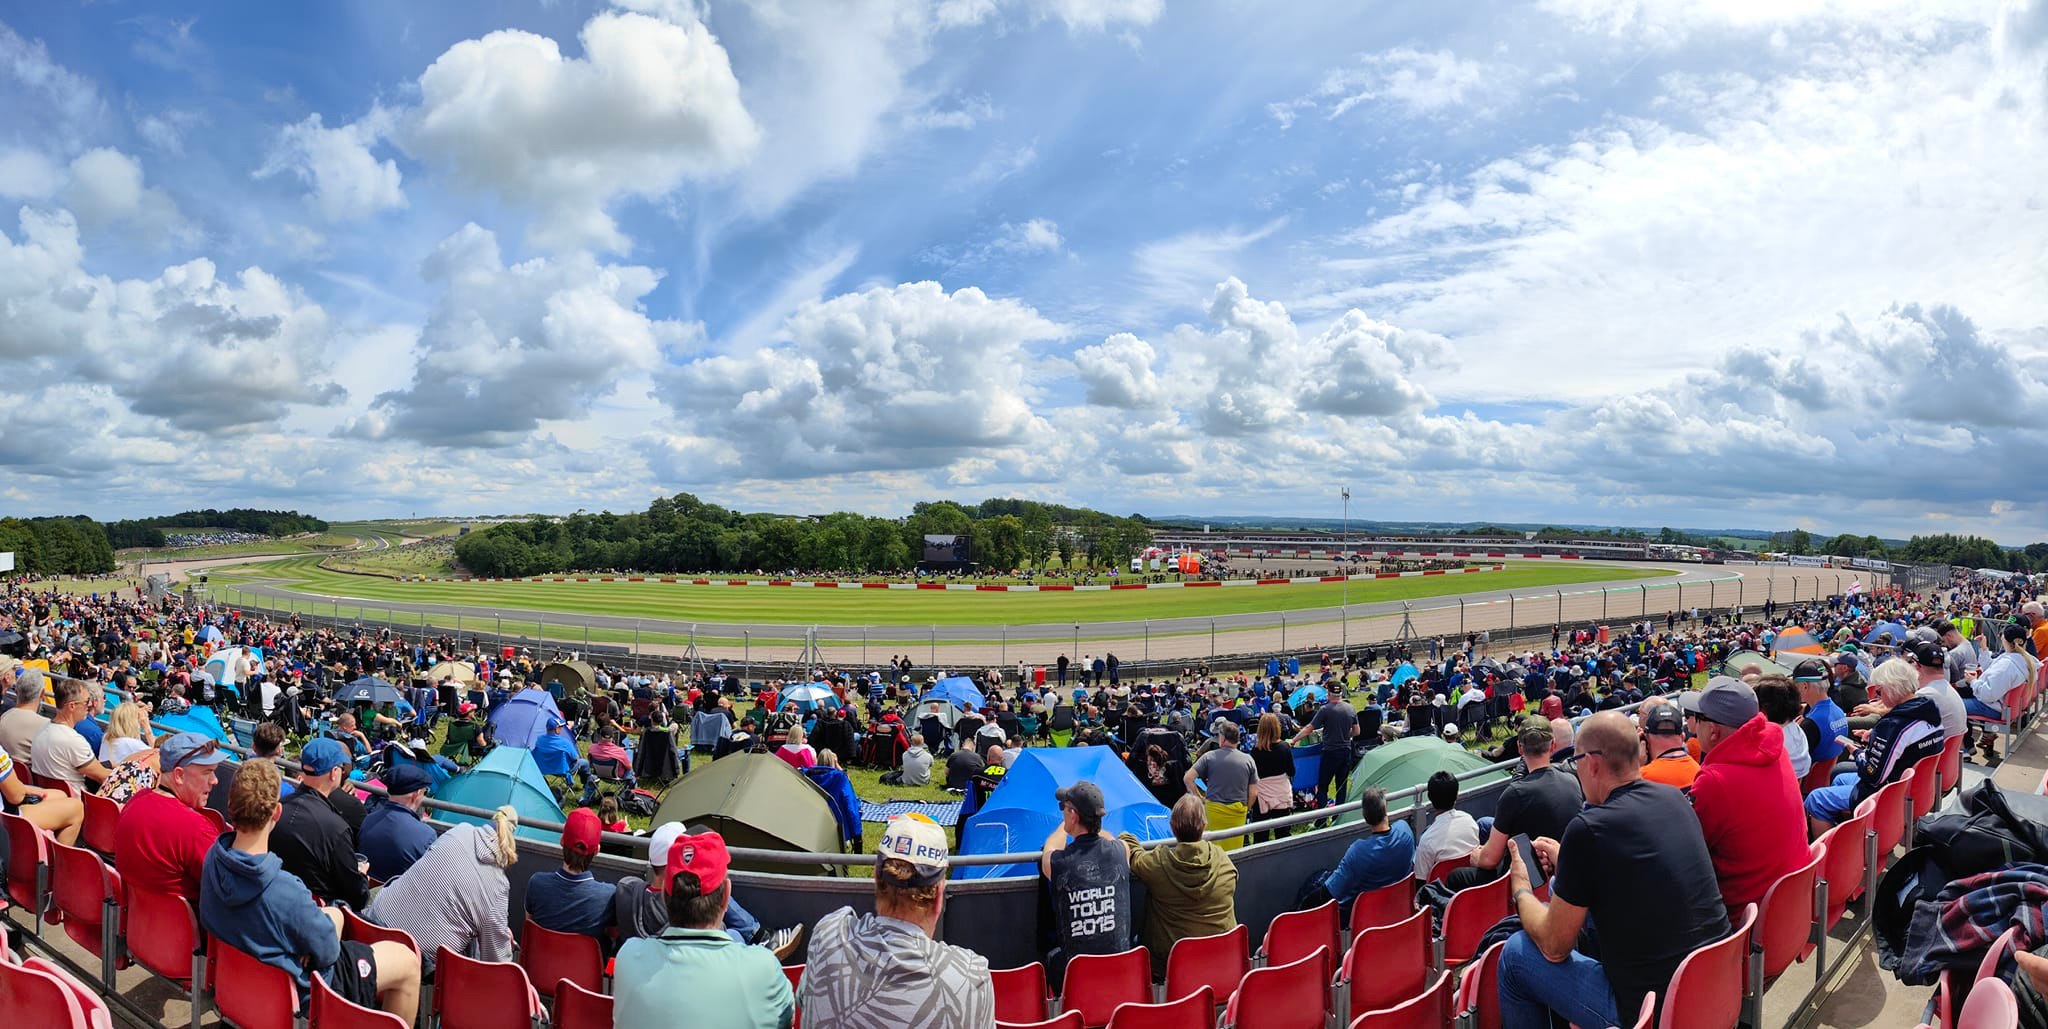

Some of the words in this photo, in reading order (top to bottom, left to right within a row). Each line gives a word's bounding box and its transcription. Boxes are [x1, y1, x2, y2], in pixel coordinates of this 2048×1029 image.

[983, 765, 1006, 776] 46
[1068, 886, 1115, 903] WORLD
[1070, 899, 1115, 918] TOUR
[1071, 915, 1115, 937] 2015
